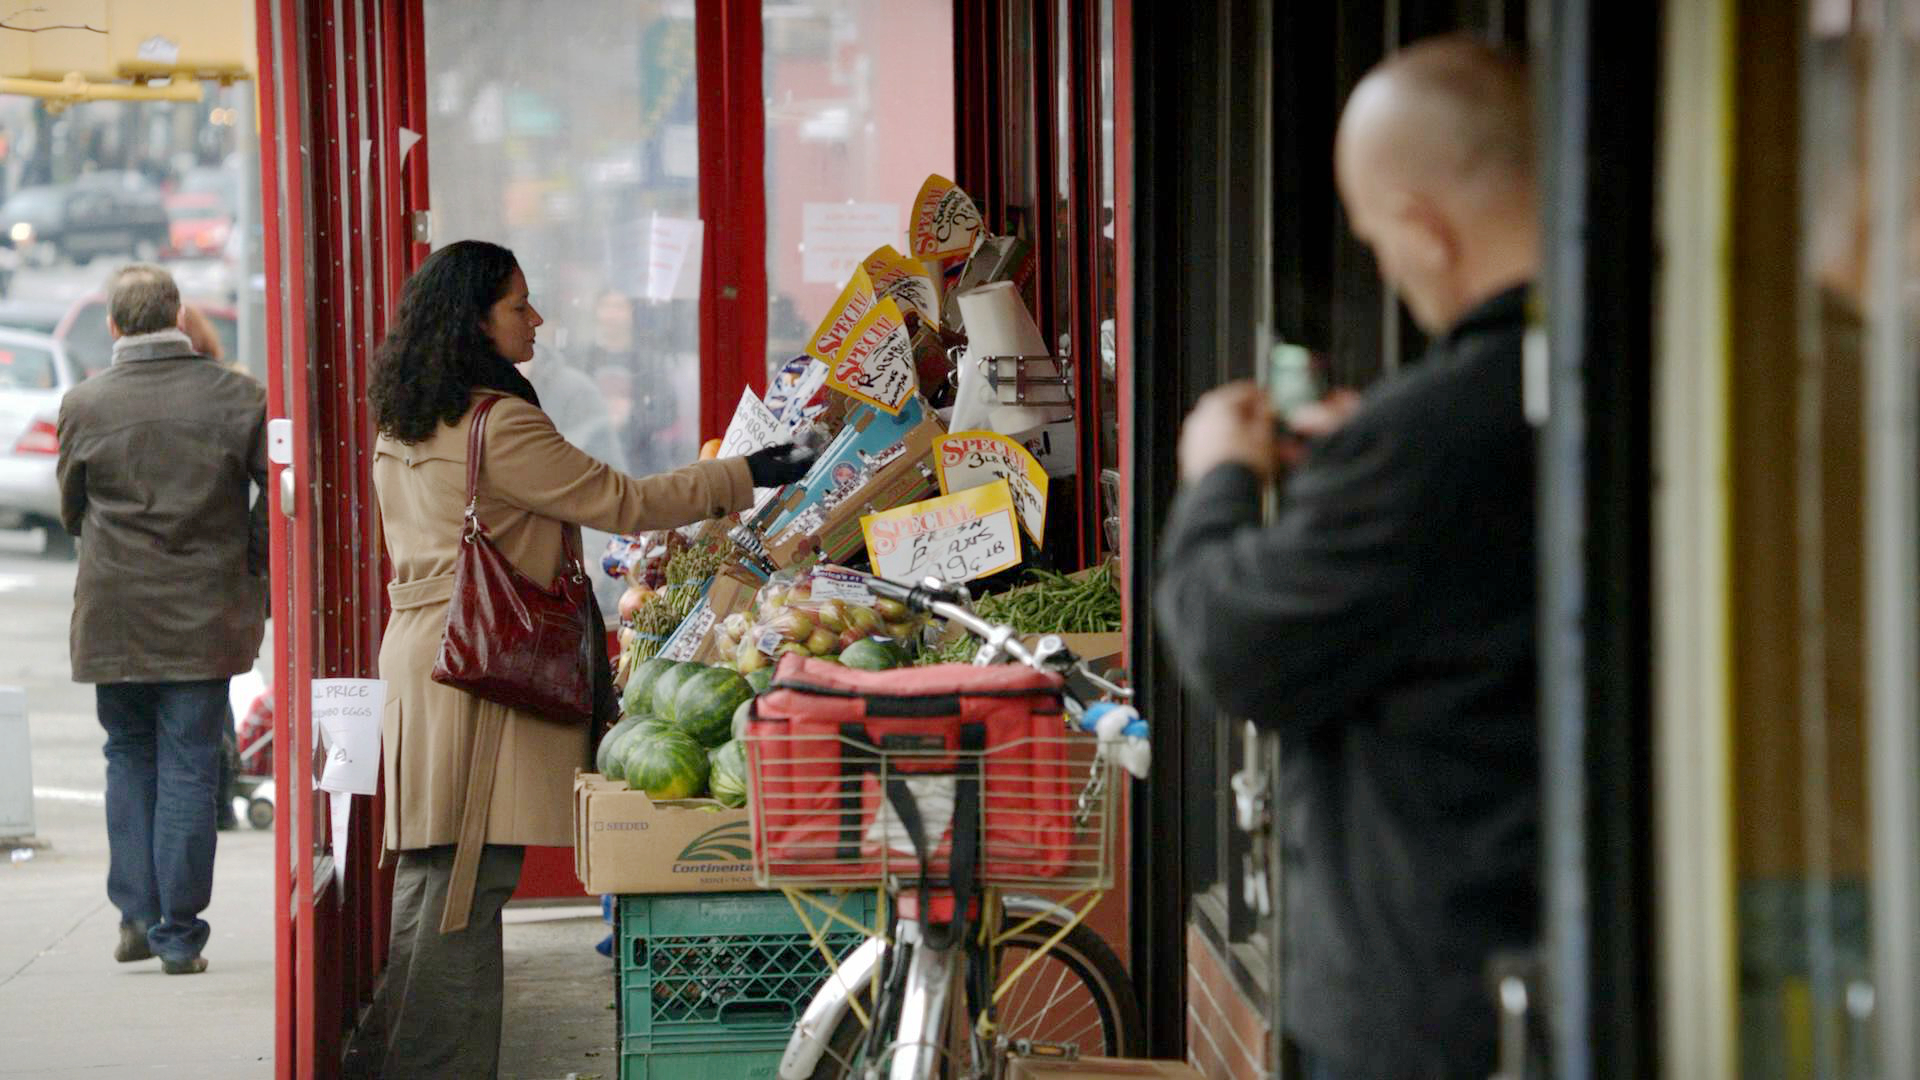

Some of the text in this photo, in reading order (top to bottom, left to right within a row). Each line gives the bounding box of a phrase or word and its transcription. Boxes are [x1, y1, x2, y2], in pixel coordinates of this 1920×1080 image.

[816, 287, 868, 360] SPECIAL
[835, 314, 895, 390] SPECIAL
[943, 439, 1027, 473] SPECIAL
[872, 503, 977, 556] SPECIAL
[326, 685, 369, 698] PRICE
[342, 706, 372, 717] EGGS
[607, 822, 649, 831] SEEDED
[672, 863, 754, 873] Continenta
